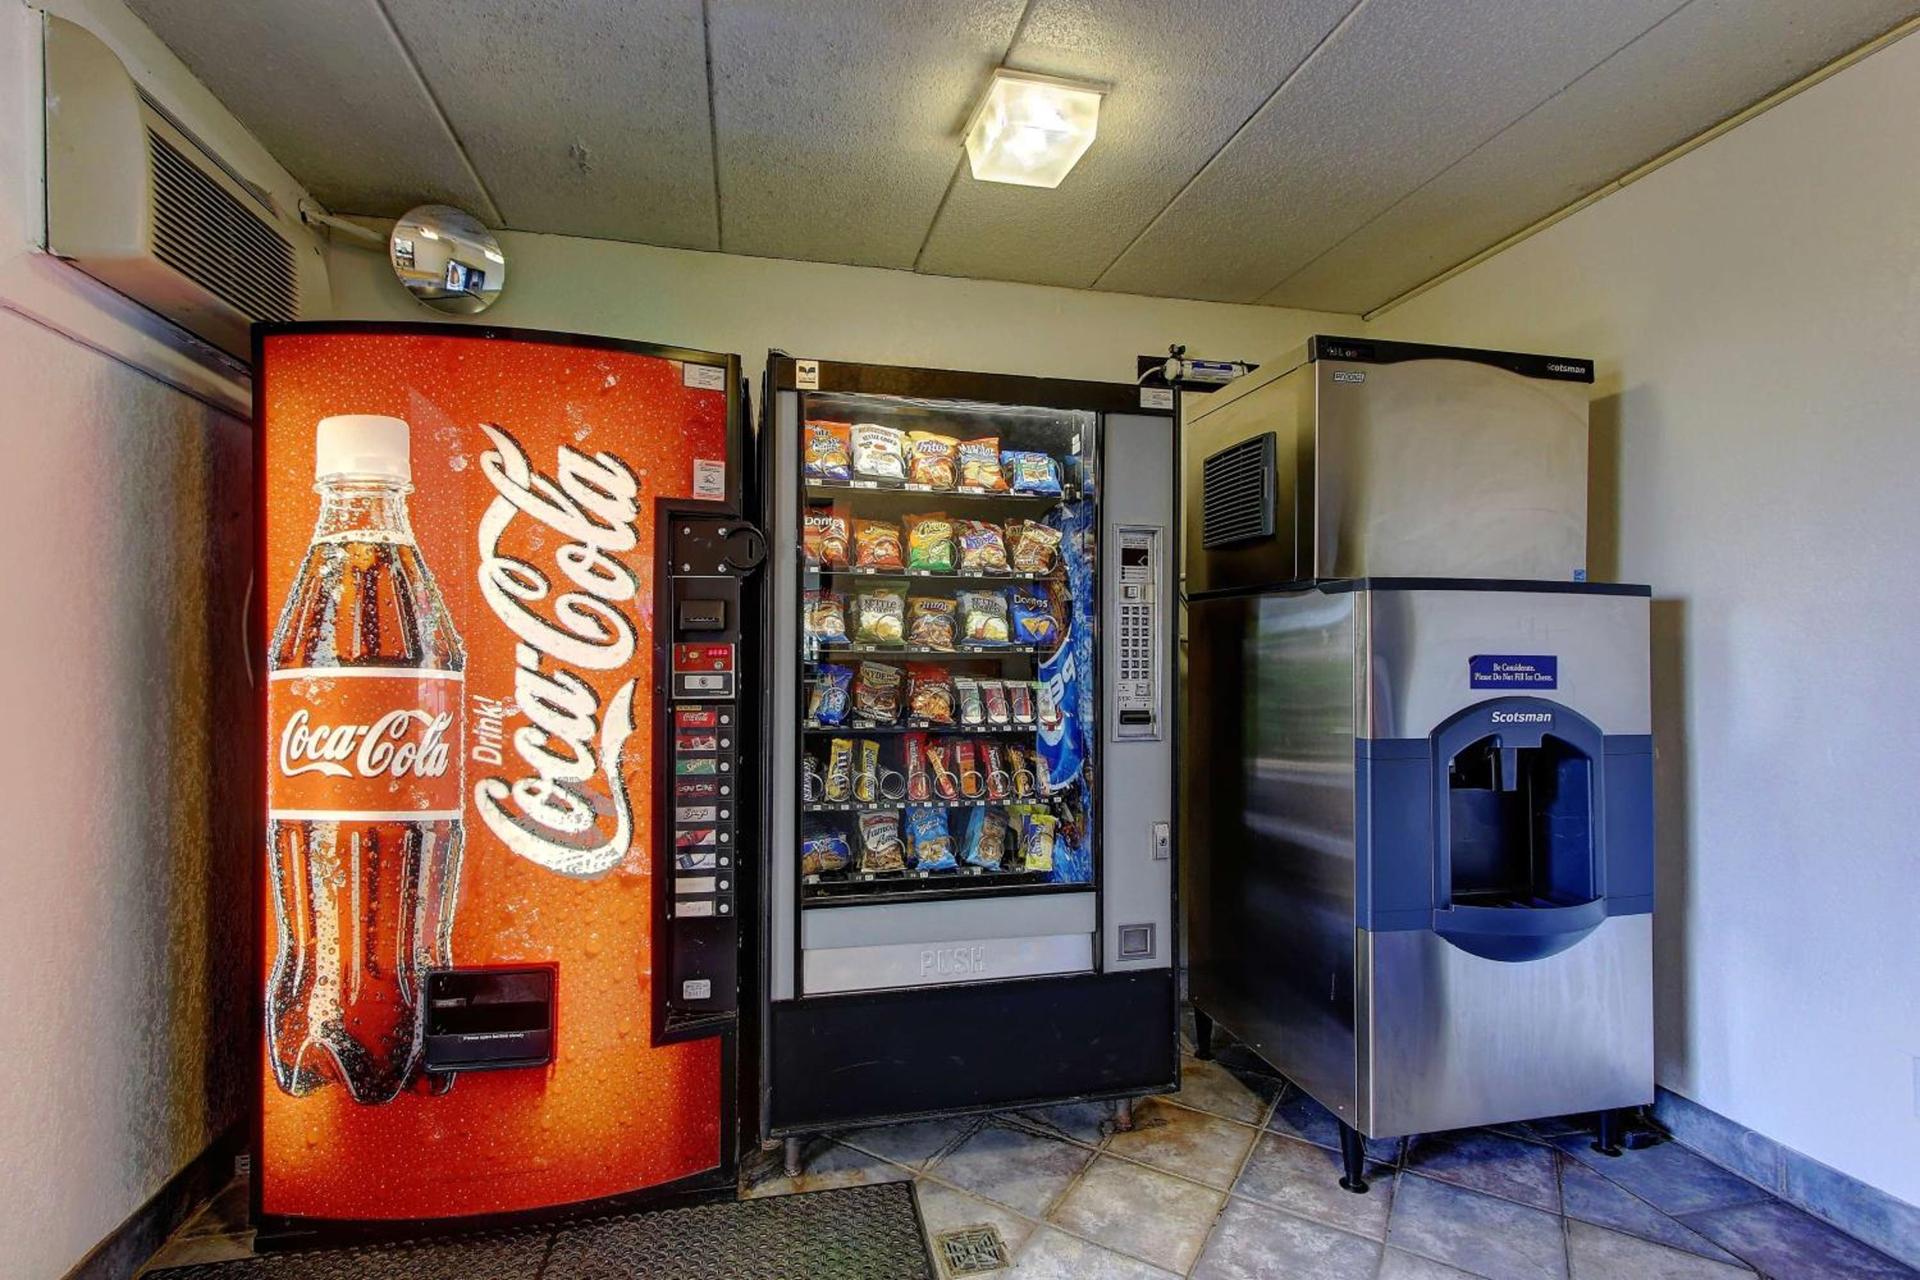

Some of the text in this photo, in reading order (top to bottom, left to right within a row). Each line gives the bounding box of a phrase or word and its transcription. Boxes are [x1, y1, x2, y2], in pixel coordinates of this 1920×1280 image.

[804, 516, 845, 528] Doritos
[1014, 594, 1048, 608] Doritos
[474, 422, 642, 880] Coca-Cola
[472, 695, 503, 766] Drink!
[1491, 711, 1552, 723] Scotsman
[279, 708, 454, 779] Coca-Cola
[920, 945, 985, 977] PUSH
